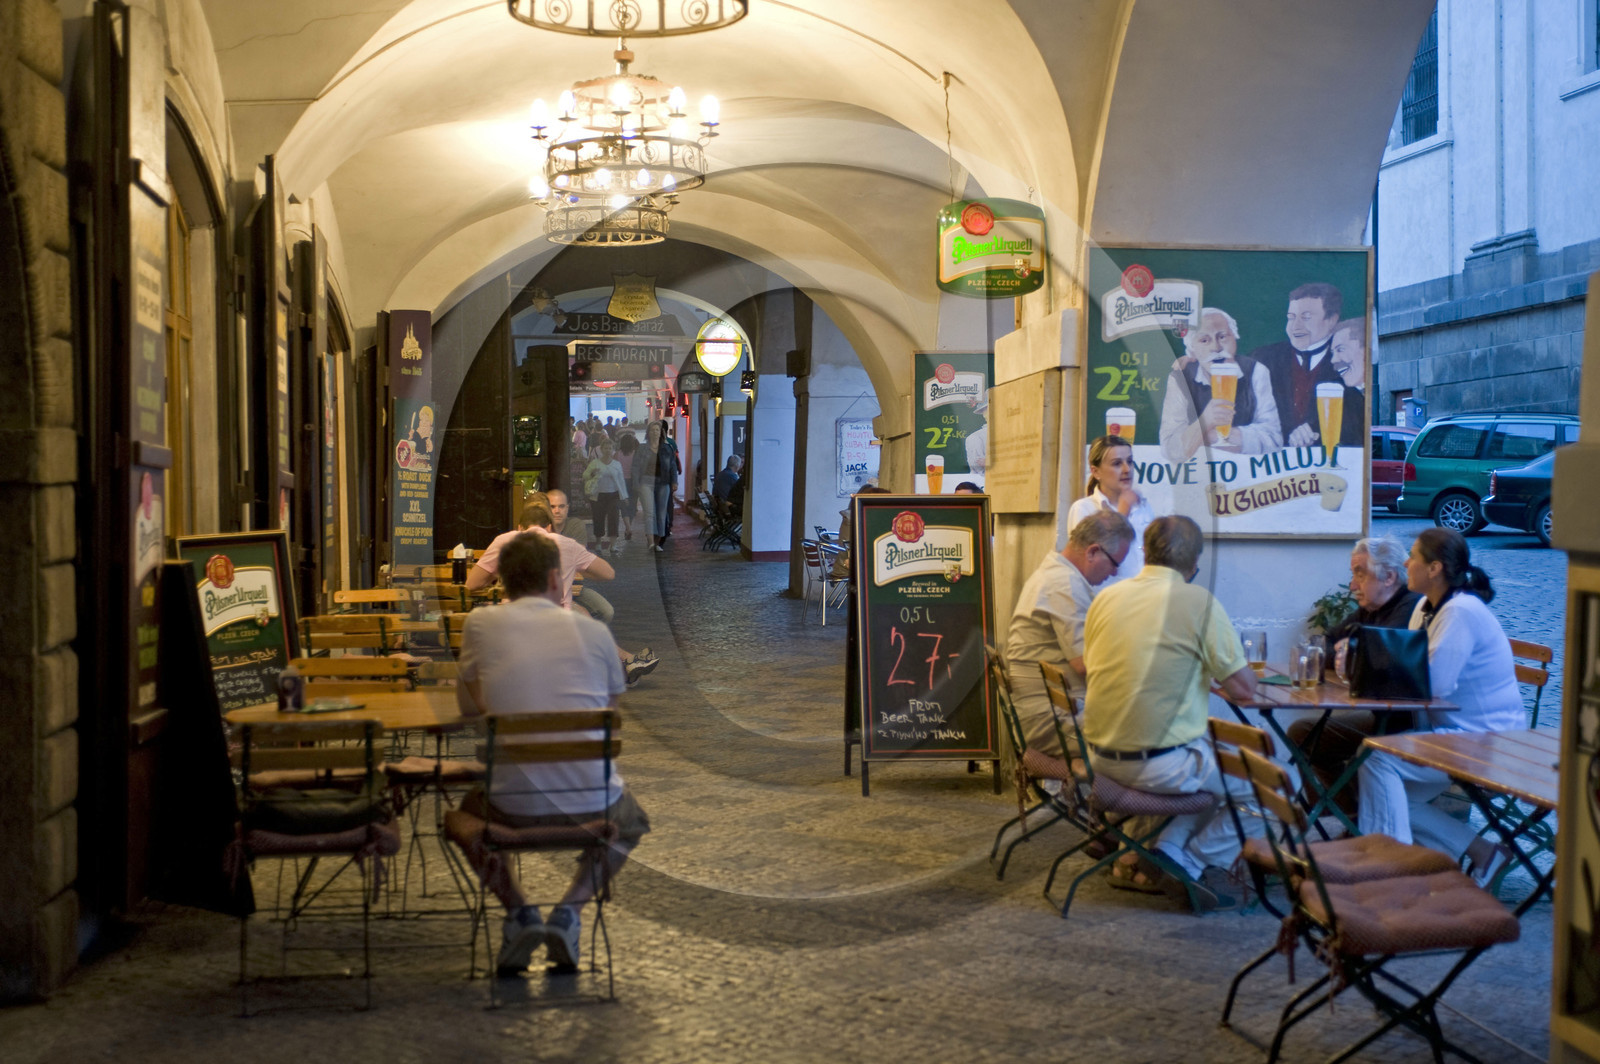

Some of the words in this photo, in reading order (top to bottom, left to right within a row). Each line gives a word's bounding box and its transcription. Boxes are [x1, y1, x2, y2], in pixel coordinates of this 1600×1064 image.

[952, 236, 994, 264] Pilsner
[993, 235, 1032, 256] Urquell
[1115, 296, 1154, 325] Pilsner
[1153, 295, 1192, 317] Urquell
[569, 315, 598, 333] Jo's
[601, 316, 624, 333] Bar
[577, 346, 668, 363] RESTAURANT
[930, 383, 954, 401] Pilsner
[954, 383, 978, 396] Urquell
[1416, 407, 1422, 415] P
[846, 452, 867, 462] B-52
[845, 462, 868, 473] JACK
[1205, 460, 1238, 482] TO
[402, 471, 417, 481] ROAST
[418, 472, 432, 482] DUCK
[1215, 493, 1231, 515] U
[1233, 473, 1321, 512] Glaubiců
[409, 500, 420, 512] XXL
[402, 513, 427, 523] SCHNITZEL
[395, 526, 415, 537] KNUCKLE
[415, 527, 421, 537] OF
[421, 527, 433, 537] PORK
[885, 542, 925, 571] Pilsner
[924, 542, 963, 562] Urquell
[205, 588, 237, 621] Pilsner
[235, 585, 267, 606] Urquell
[908, 698, 942, 714] FROM
[880, 711, 913, 724] BEER
[916, 713, 947, 724] TANK
